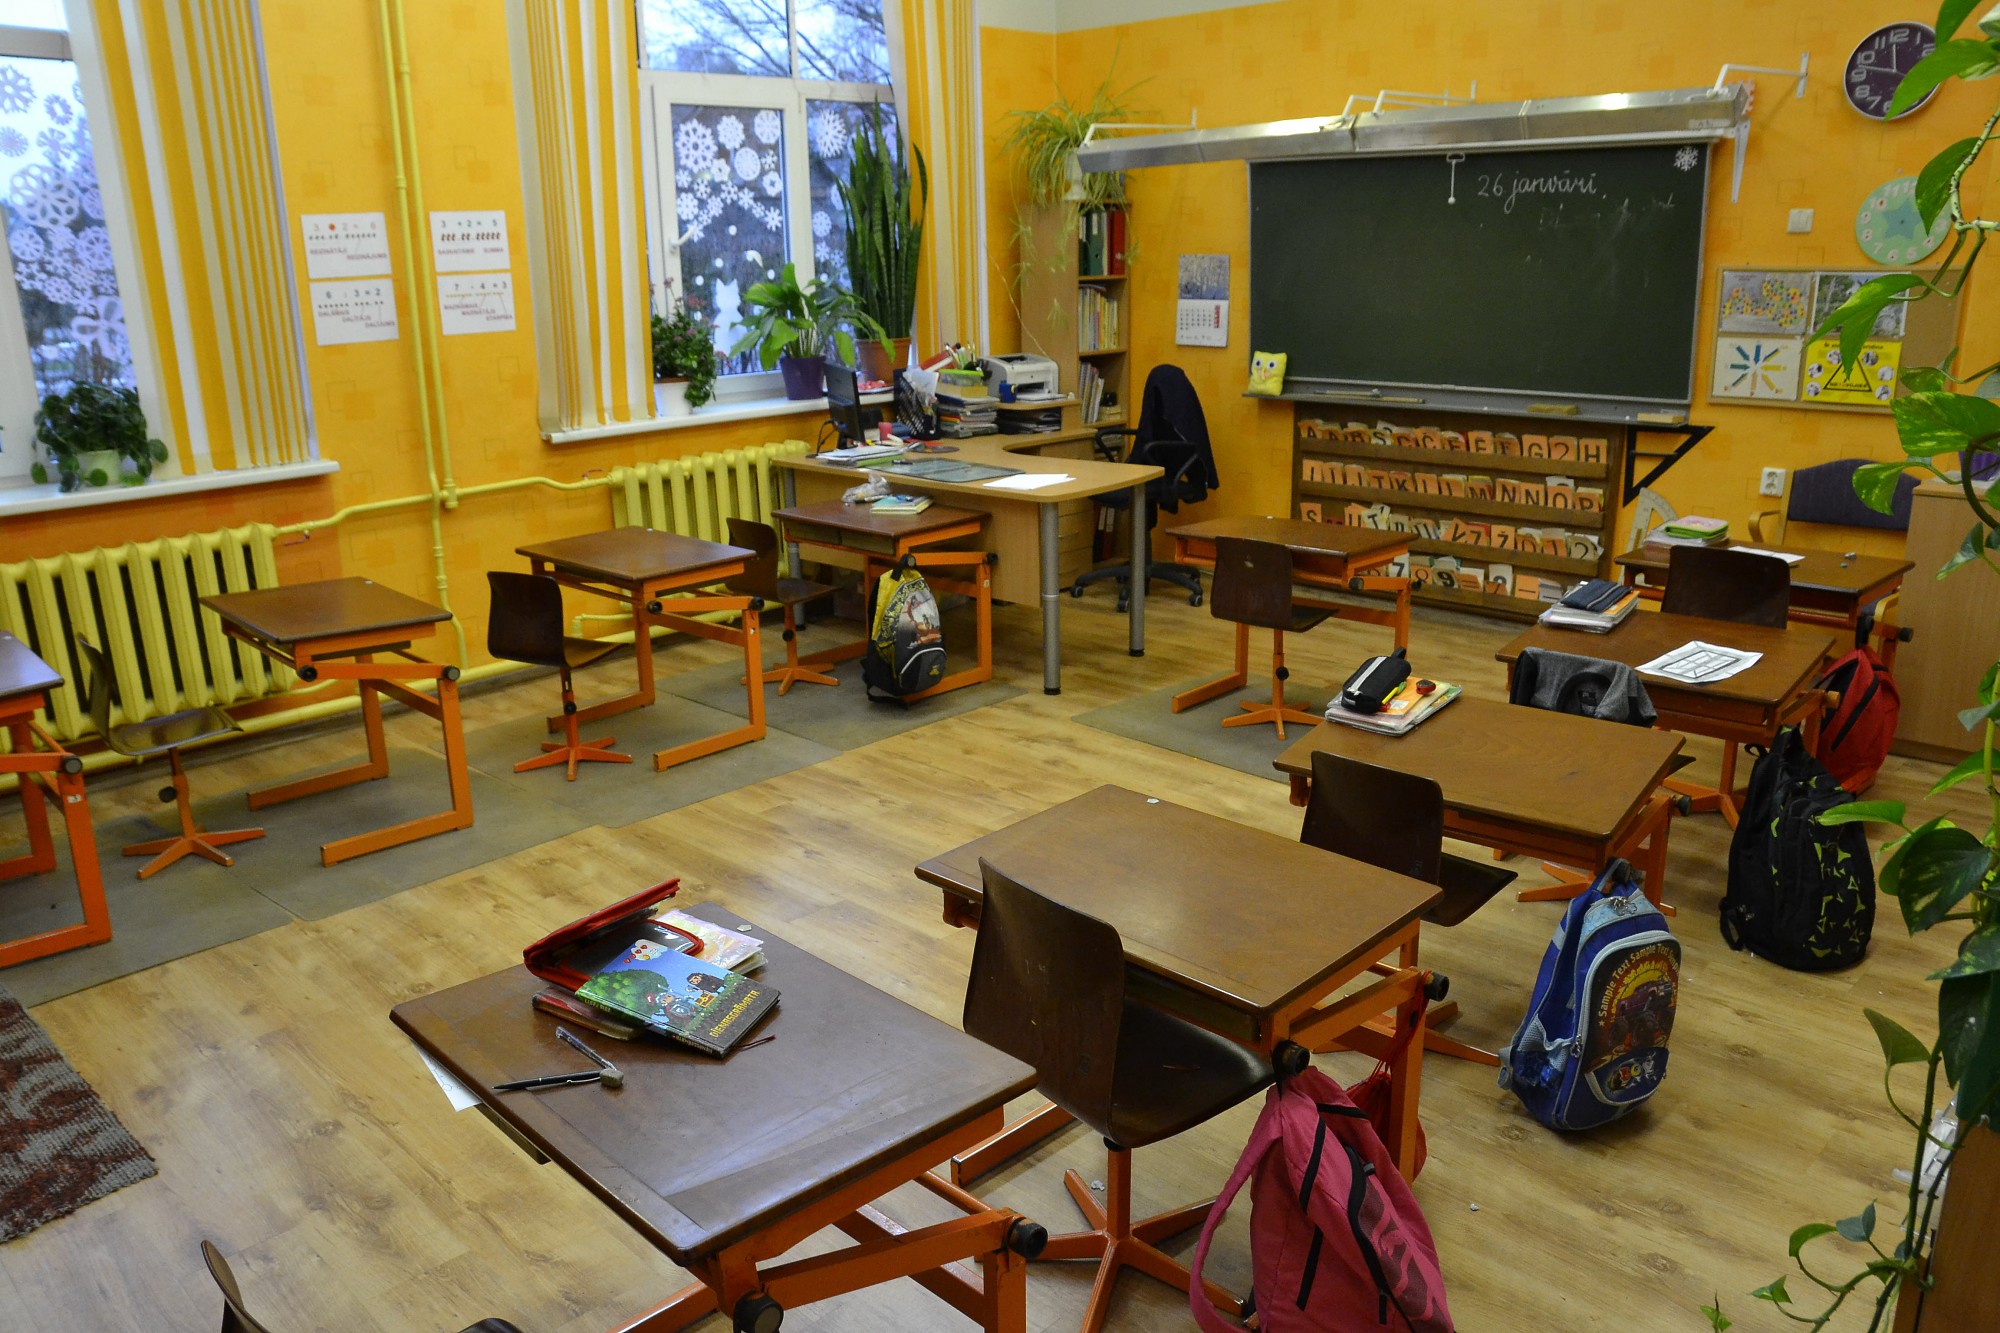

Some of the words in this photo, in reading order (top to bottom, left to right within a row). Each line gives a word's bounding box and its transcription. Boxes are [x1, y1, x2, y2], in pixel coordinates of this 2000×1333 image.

[1874, 36, 1887, 50] 11
[1889, 28, 1910, 43] 12
[1915, 31, 1921, 46] 1
[1857, 50, 1875, 65] 10
[1851, 68, 1867, 82] 9
[1855, 85, 1870, 98] 8
[1866, 96, 1882, 110] 7
[1477, 172, 1504, 197] 26
[1863, 228, 1873, 243] 8
[1528, 442, 1542, 458] G
[1583, 444, 1600, 463] H
[1501, 484, 1516, 502] N
[1525, 488, 1539, 505] N
[1598, 980, 1617, 1018] Sample
[1612, 959, 1631, 979] Text
[1630, 944, 1656, 963] Sample
[1657, 943, 1670, 955] Text
